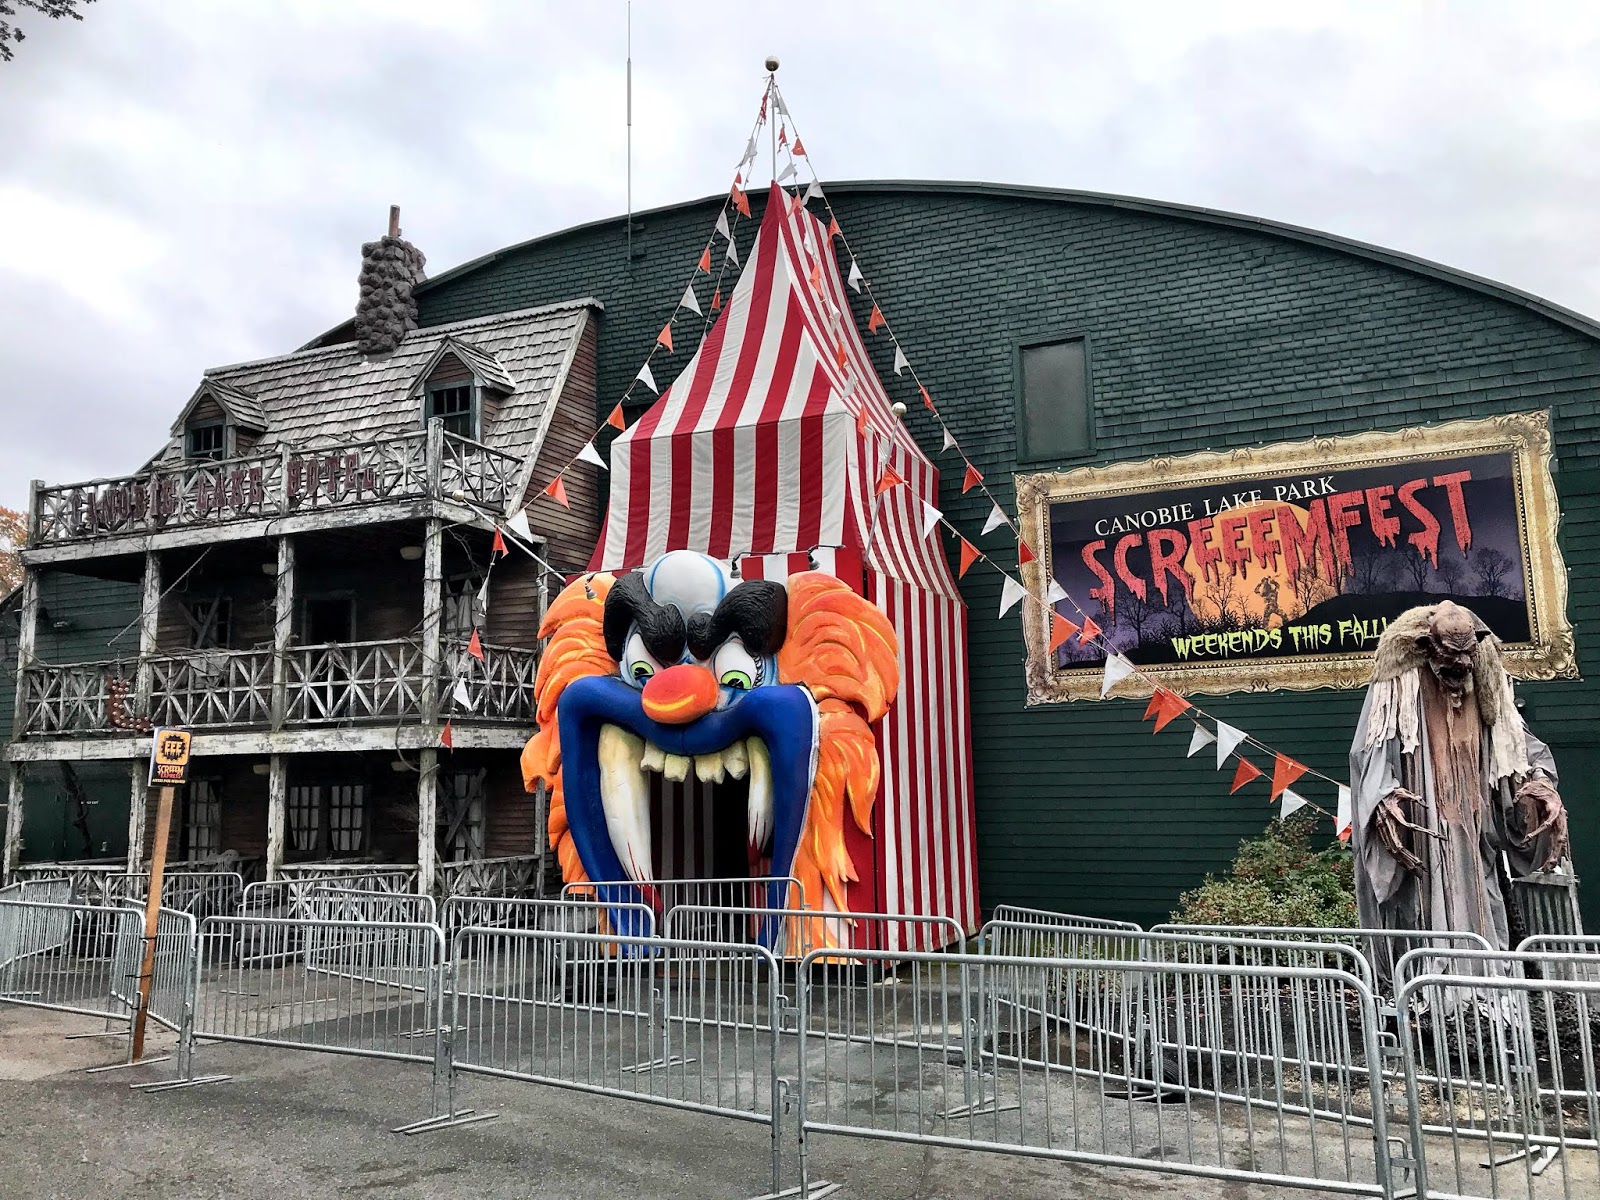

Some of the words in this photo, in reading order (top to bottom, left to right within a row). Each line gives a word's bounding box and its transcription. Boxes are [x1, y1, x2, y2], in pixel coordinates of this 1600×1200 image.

[195, 467, 265, 511] LAKE
[286, 452, 377, 497] HOTEL
[1094, 502, 1195, 536] CANOBIE
[1203, 489, 1265, 516] LAKE
[1272, 475, 1338, 502] PARK
[1080, 470, 1473, 626] SCREEEMFEST
[1171, 626, 1283, 660] WEEKENDS
[1288, 623, 1332, 652] THIS
